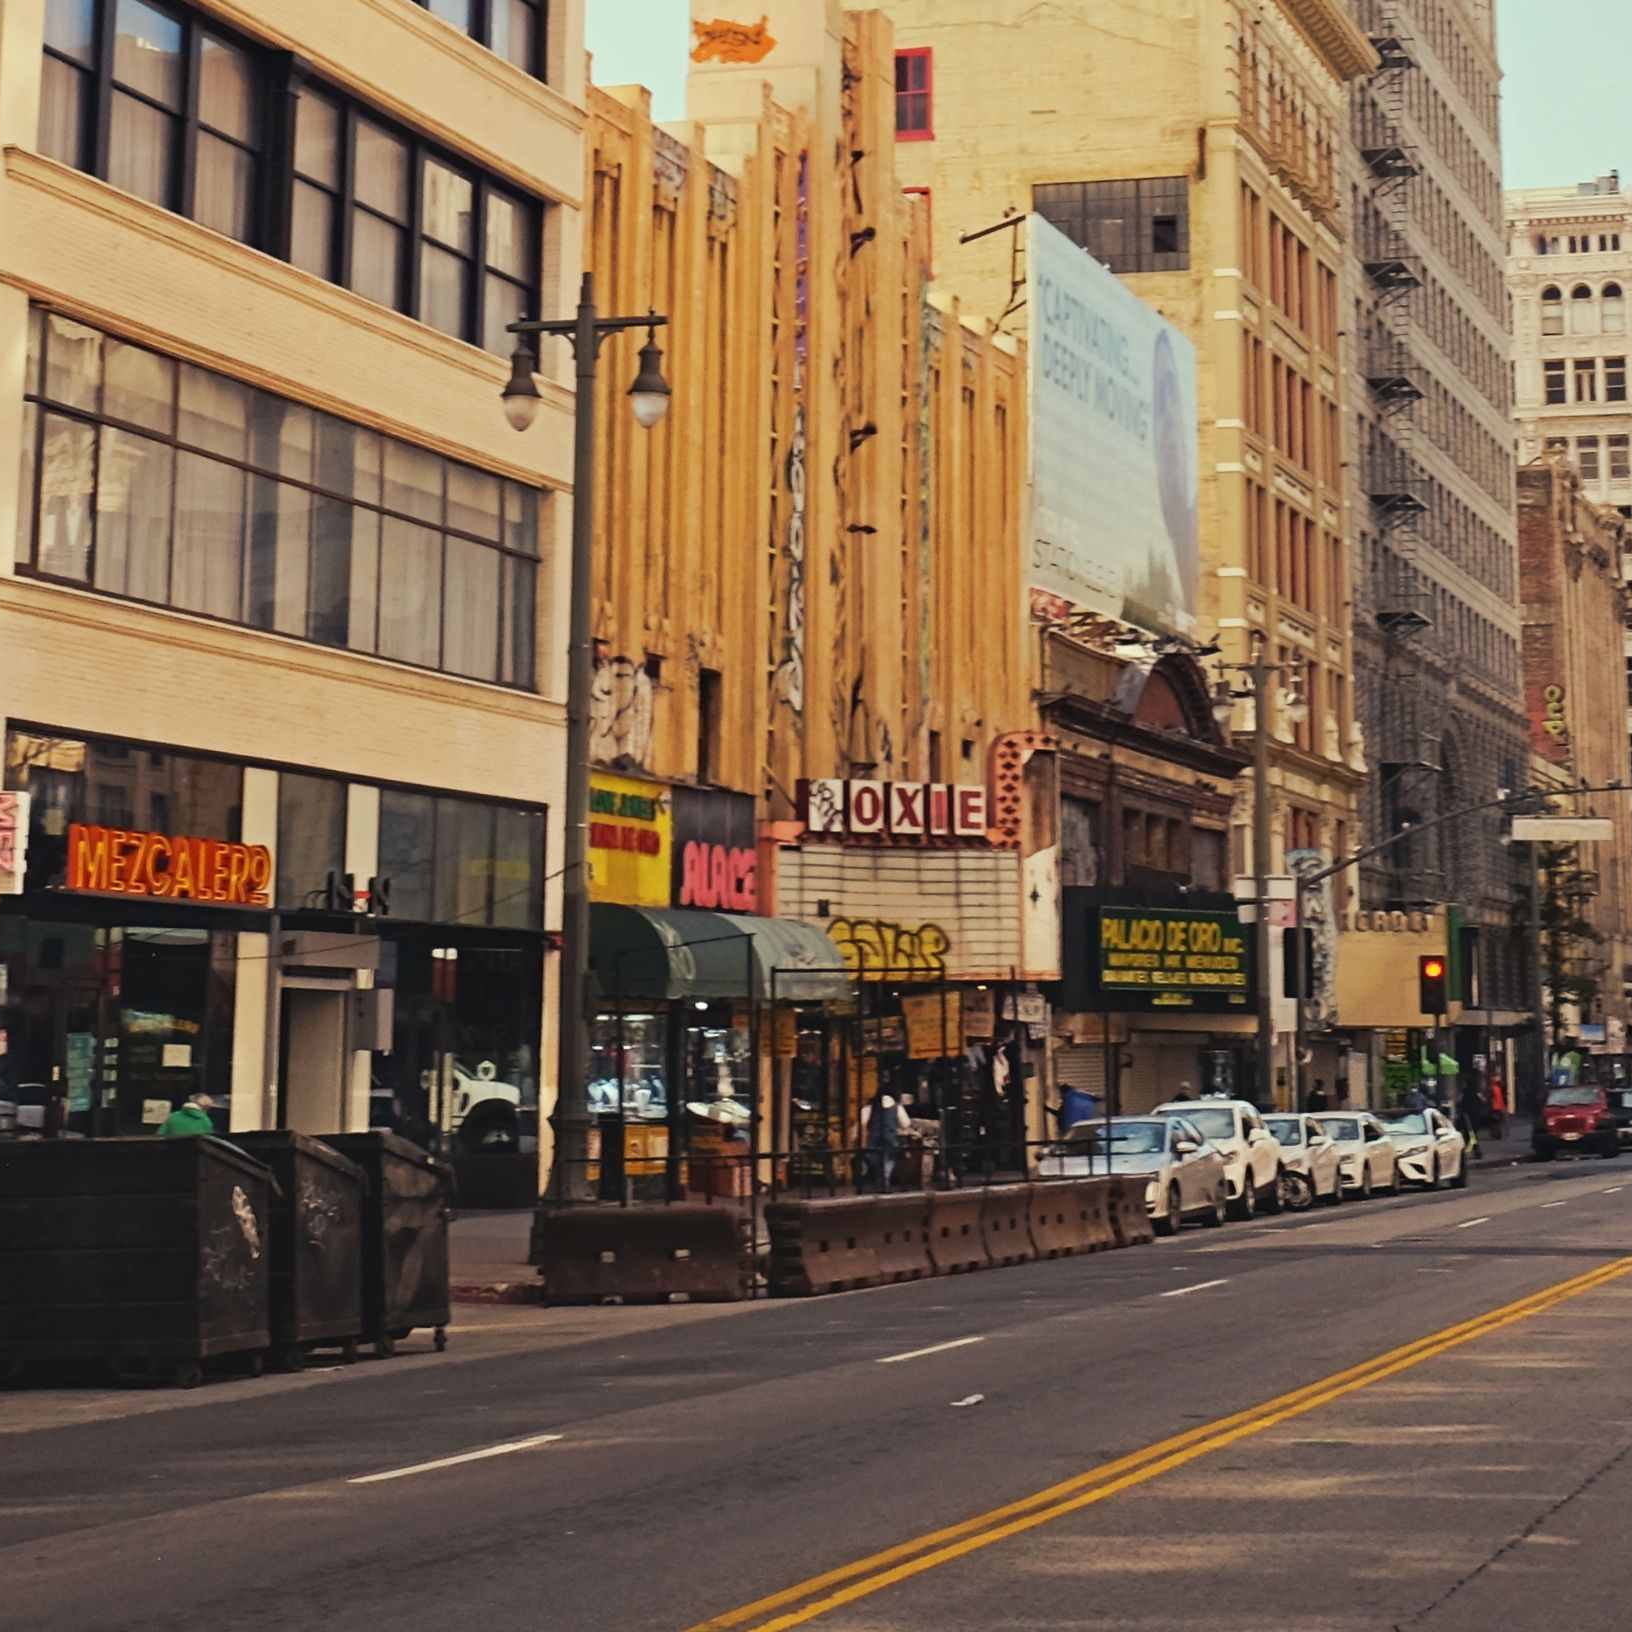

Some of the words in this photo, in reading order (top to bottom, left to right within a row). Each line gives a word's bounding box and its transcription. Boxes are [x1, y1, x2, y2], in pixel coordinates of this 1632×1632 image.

[823, 786, 983, 831] OXIE
[74, 825, 270, 904] MEZCALERO
[1101, 917, 1165, 951] PALACIO
[1166, 920, 1187, 952] DE
[1188, 920, 1222, 953] ORO
